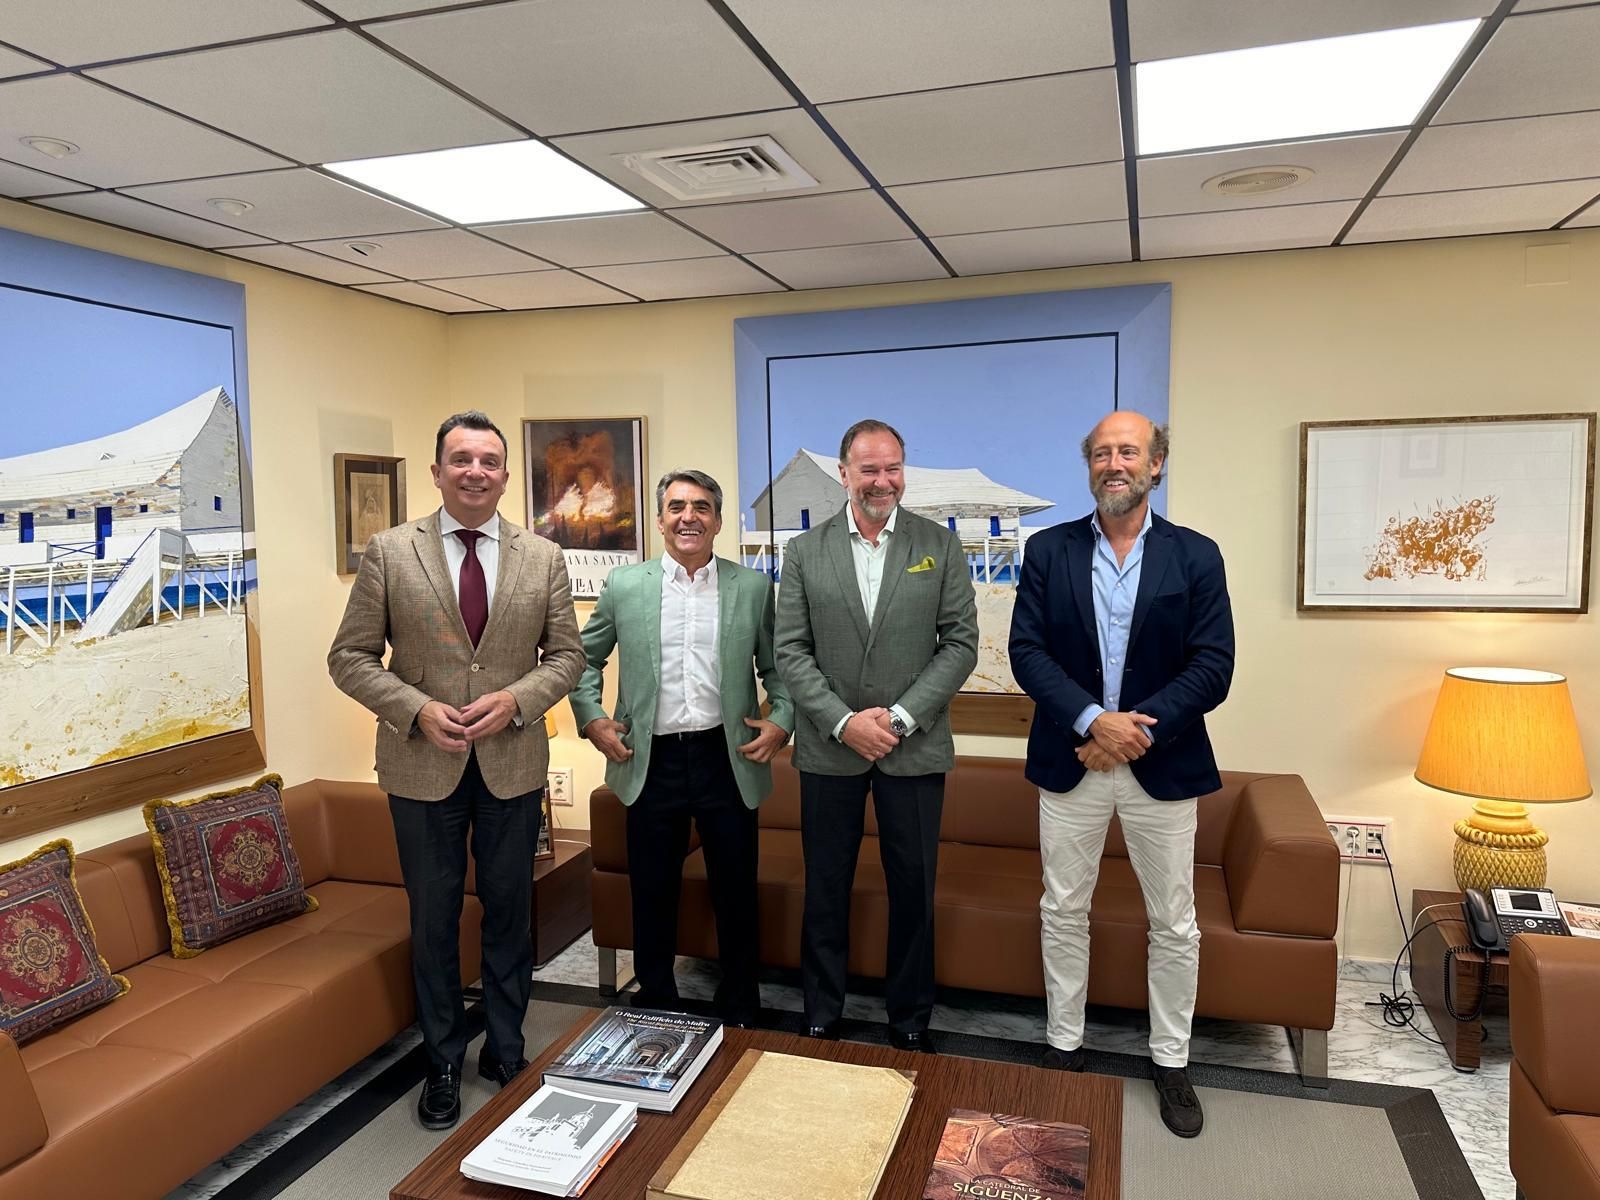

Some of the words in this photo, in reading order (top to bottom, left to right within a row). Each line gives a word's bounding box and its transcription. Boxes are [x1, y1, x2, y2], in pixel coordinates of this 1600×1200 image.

[568, 555, 588, 566] ANA
[593, 555, 630, 566] SANTA
[623, 1011, 642, 1019] Real
[685, 1019, 710, 1027] Mafra
[983, 1181, 1027, 1192] CATEDRAL
